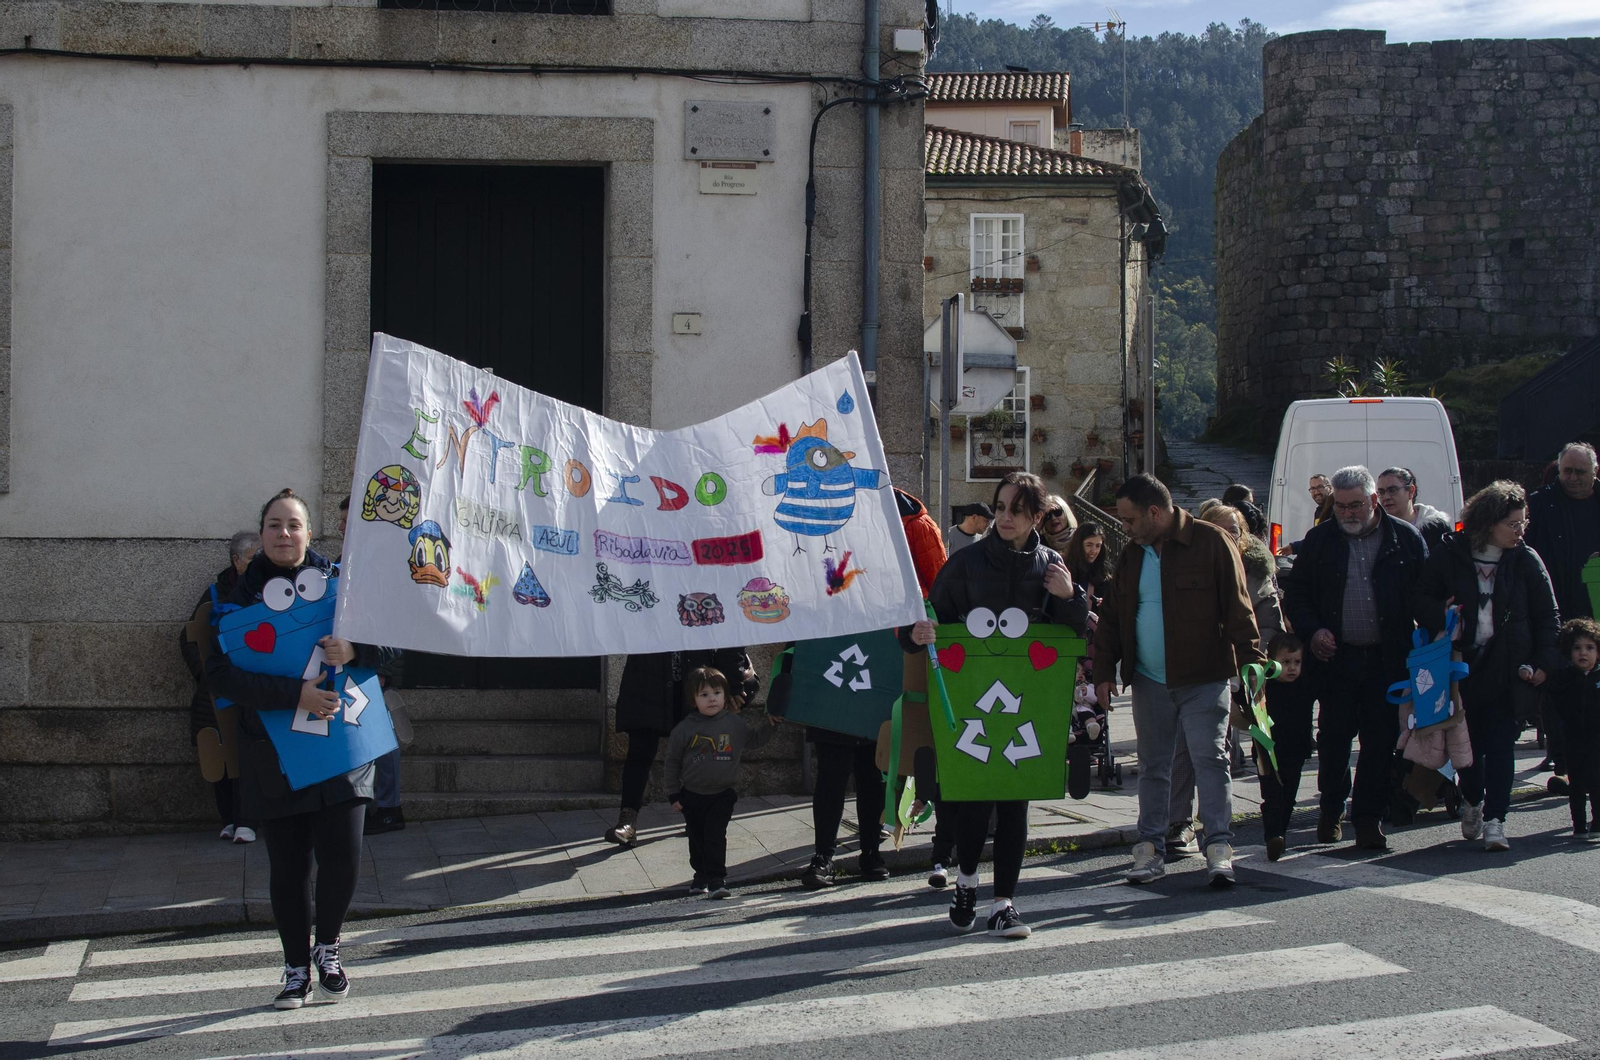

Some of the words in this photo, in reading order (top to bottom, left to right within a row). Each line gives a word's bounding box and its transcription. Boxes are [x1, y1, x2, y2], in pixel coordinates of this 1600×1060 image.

[684, 318, 691, 330] 4
[401, 406, 728, 512] ENTROIDO
[538, 528, 574, 553] AZUL
[598, 534, 690, 560] Ribadavia
[700, 539, 751, 560] 2025
